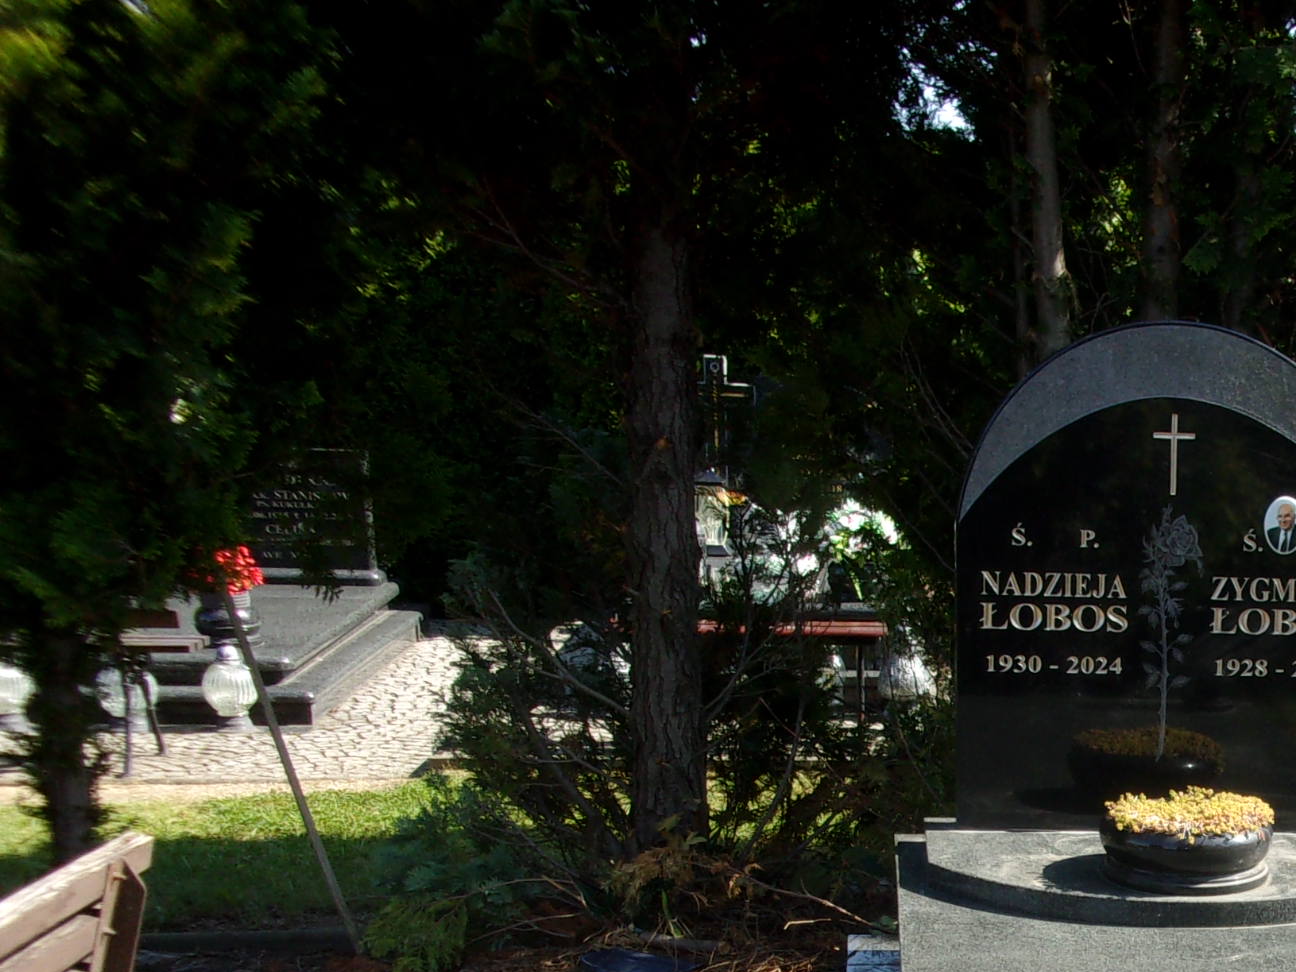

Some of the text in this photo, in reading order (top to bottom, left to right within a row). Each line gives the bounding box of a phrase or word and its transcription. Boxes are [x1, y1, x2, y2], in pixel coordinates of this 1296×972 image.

[1011, 522, 1100, 549] Ś. P.
[1242, 528, 1263, 552] Ś.
[980, 570, 1128, 599] NADZIEJA
[979, 601, 1129, 633] ŁOBOS
[986, 654, 1042, 674] 1930
[1066, 655, 1122, 675] 2024
[1215, 658, 1269, 677] 1928
